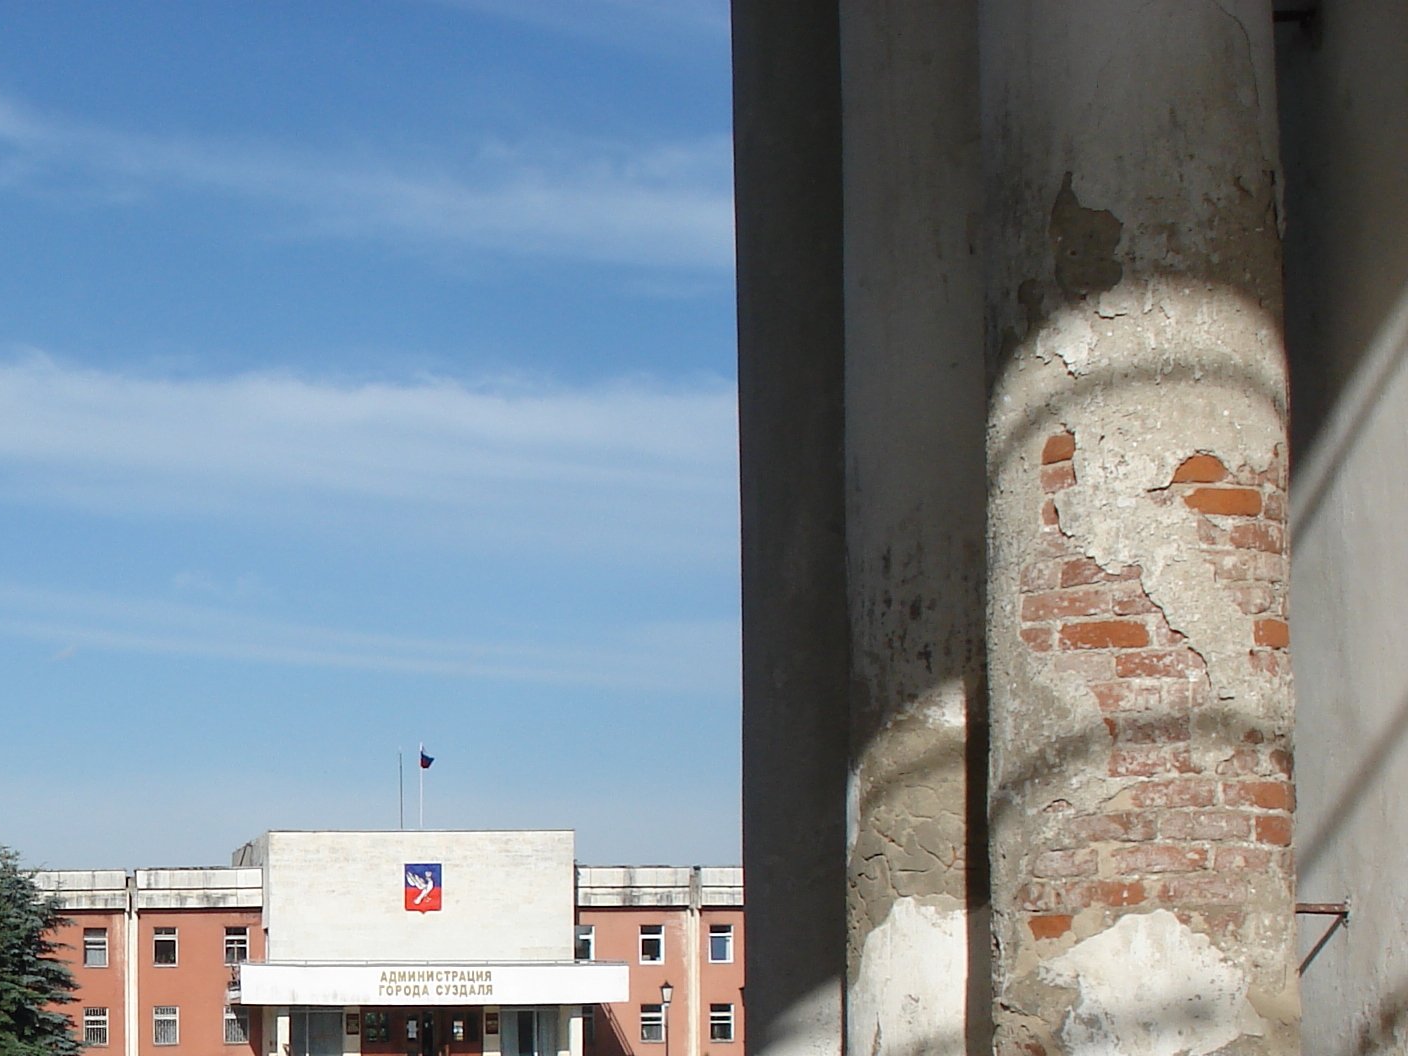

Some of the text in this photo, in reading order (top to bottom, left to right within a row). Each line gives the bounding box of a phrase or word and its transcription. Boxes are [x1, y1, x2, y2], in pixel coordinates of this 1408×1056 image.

[380, 970, 492, 984] АДМИНИСТРАЦИЯ
[378, 984, 493, 998] ГОРОДА СУЗДАЛЯ
